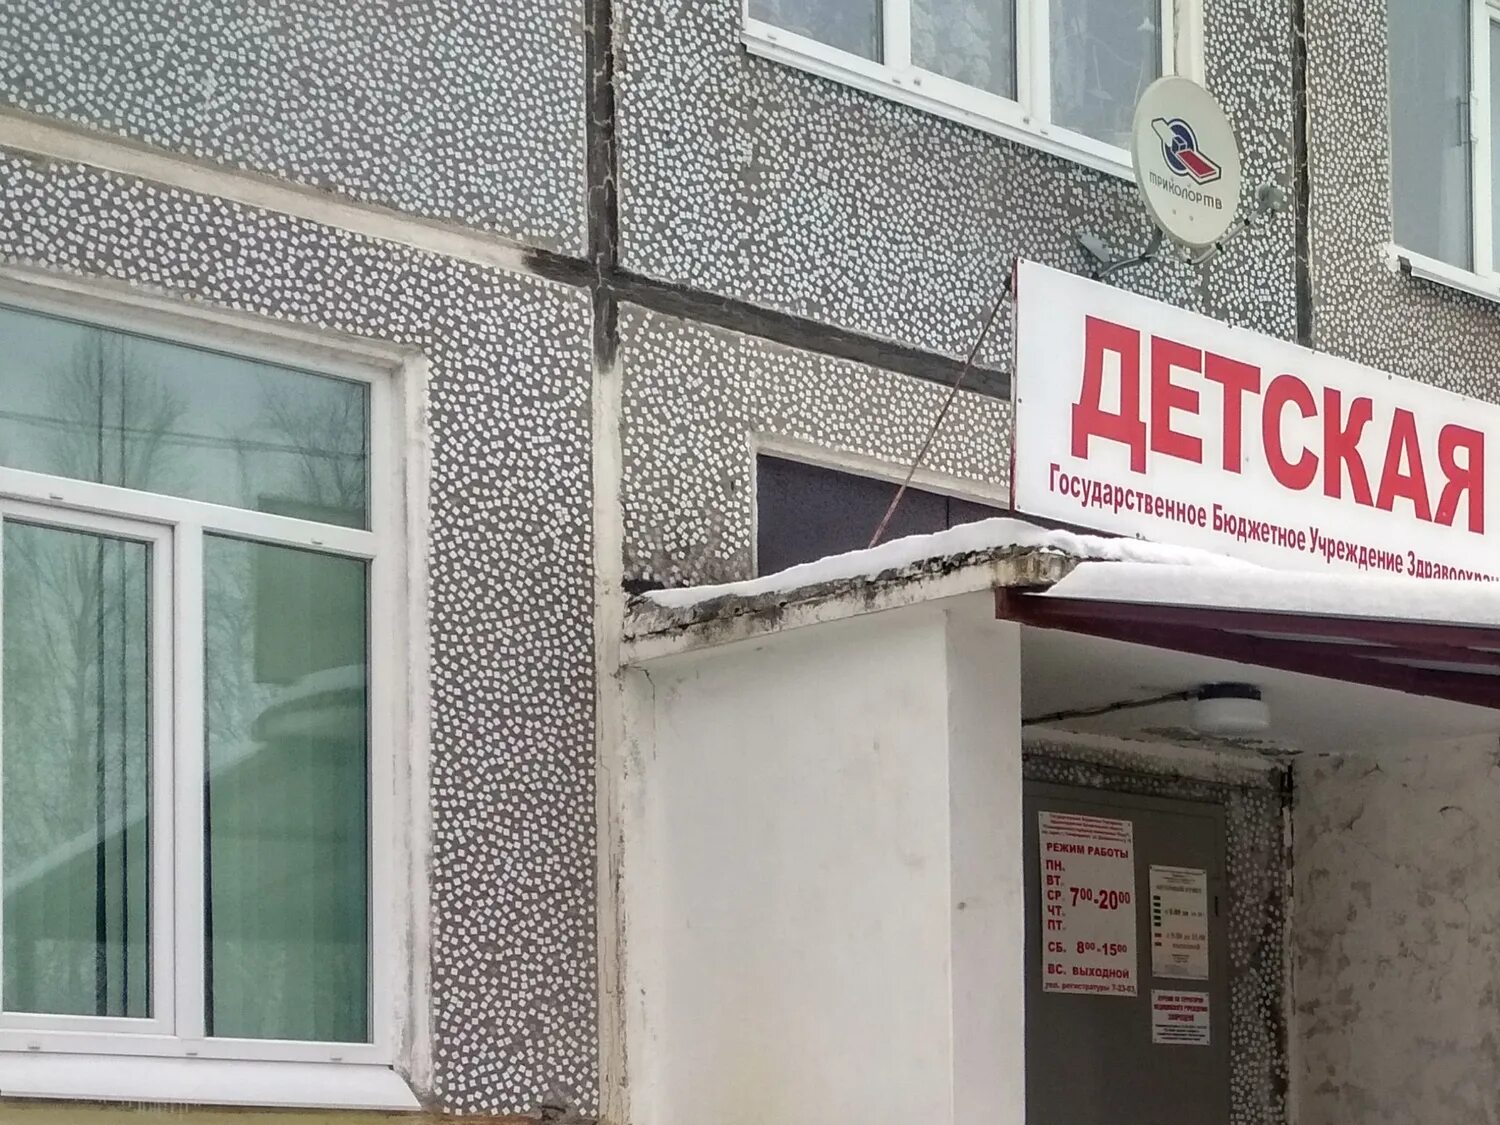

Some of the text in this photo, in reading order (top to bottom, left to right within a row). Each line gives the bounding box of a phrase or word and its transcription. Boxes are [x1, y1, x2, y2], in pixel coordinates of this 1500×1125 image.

[1071, 315, 1485, 535] ДЕТСКАЯ
[1049, 462, 1207, 529] Государственное
[1212, 503, 1306, 551] Бюджетное
[1309, 526, 1403, 573] Учреждение
[1046, 842, 1129, 858] РЕЖИМ РАБОТЫ
[1046, 859, 1066, 872] ПН.
[1047, 905, 1066, 916] ЧТ.
[1047, 919, 1067, 930] ПТ.
[1048, 941, 1067, 953] СБ.
[1048, 963, 1067, 975] ВС.
